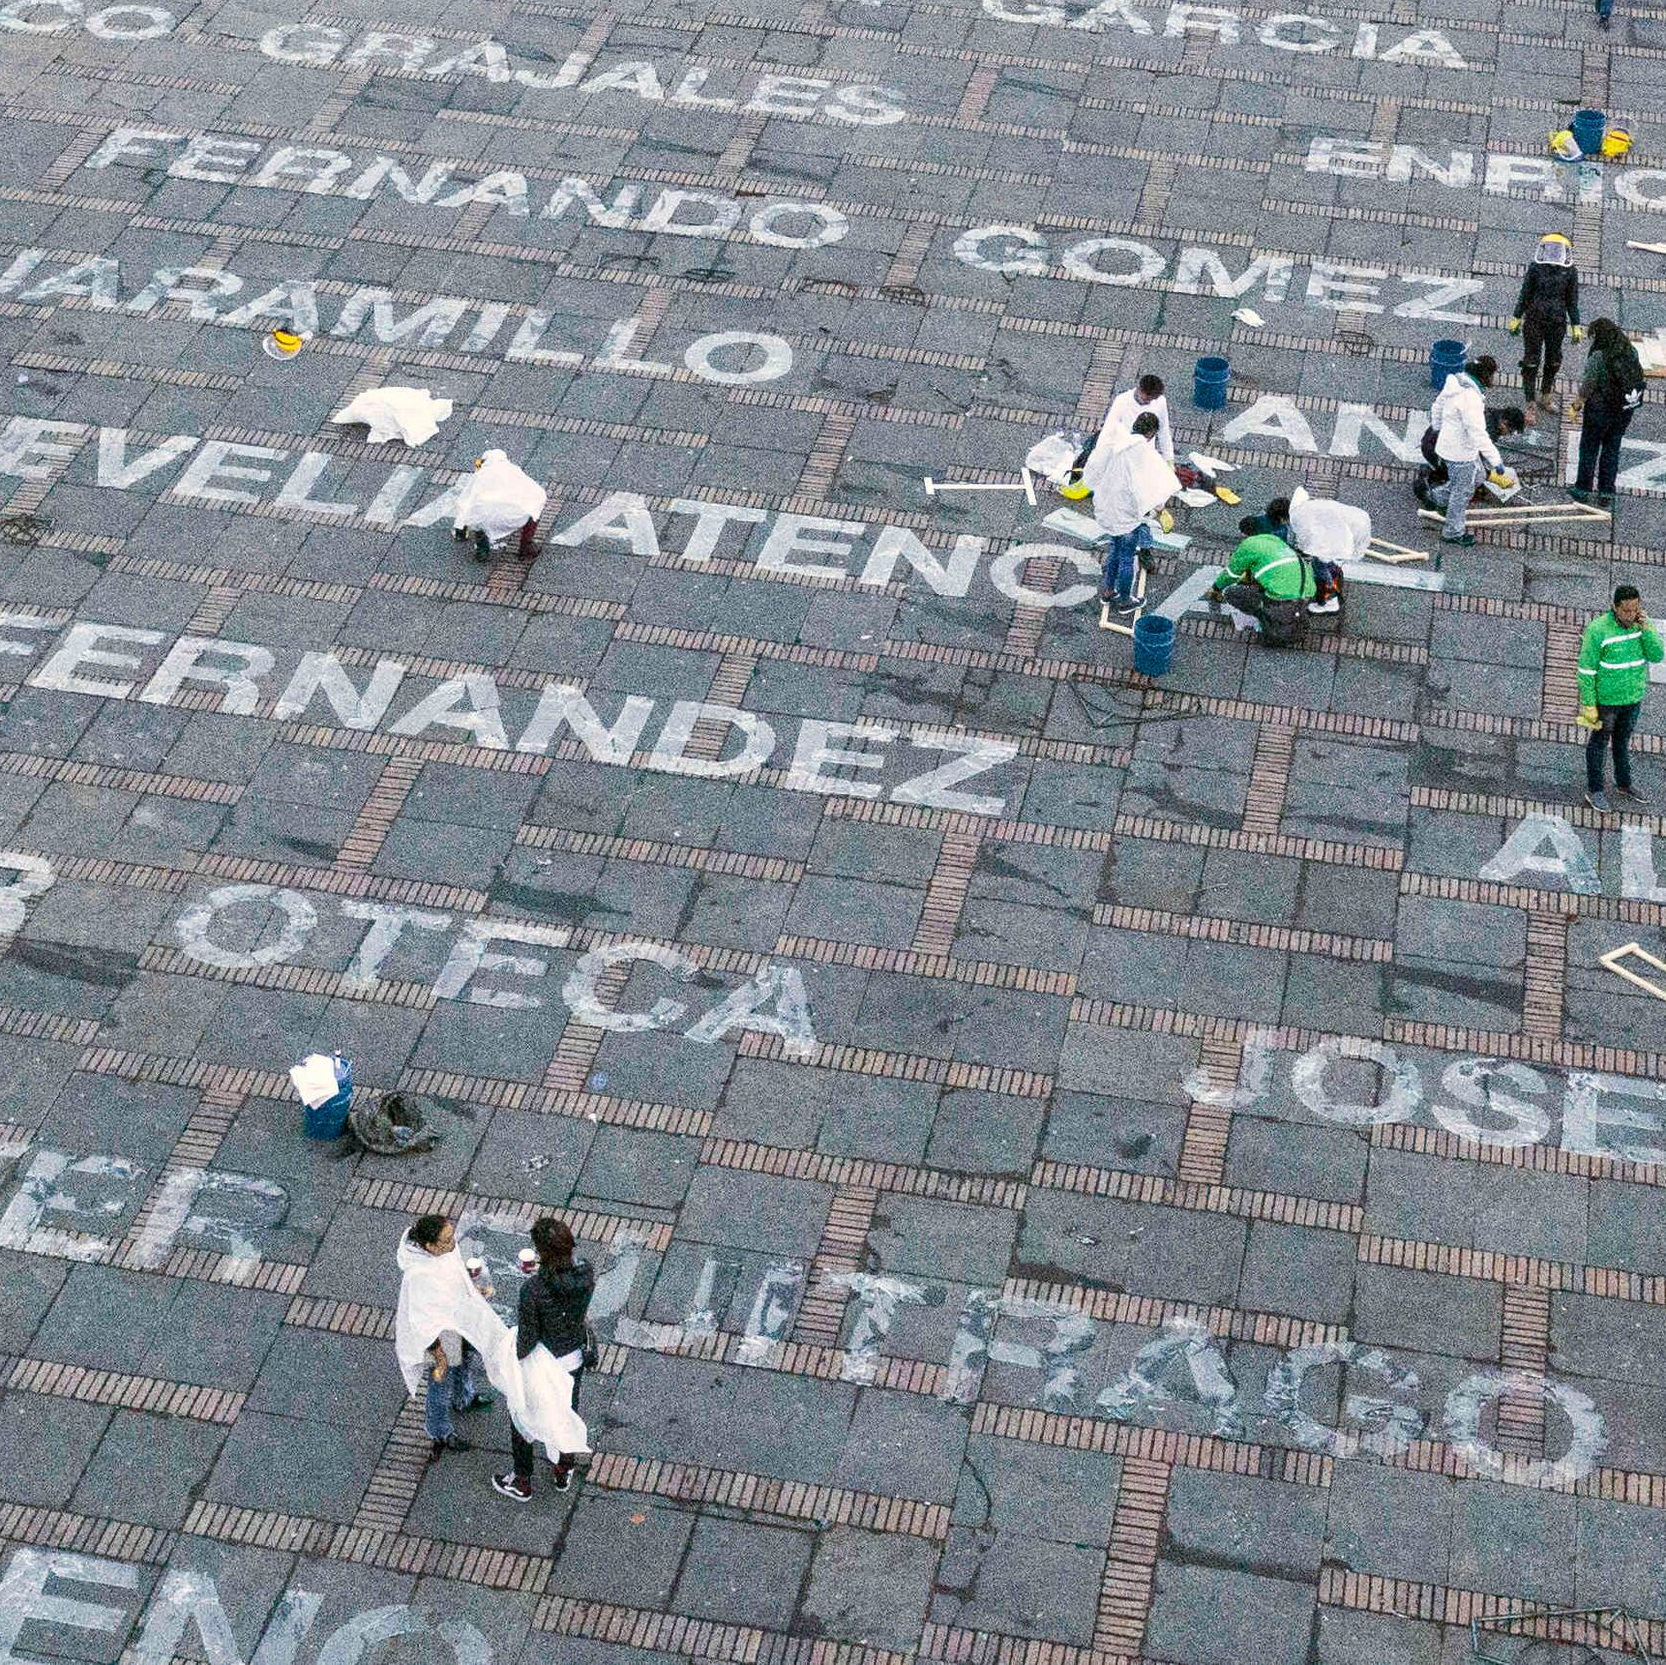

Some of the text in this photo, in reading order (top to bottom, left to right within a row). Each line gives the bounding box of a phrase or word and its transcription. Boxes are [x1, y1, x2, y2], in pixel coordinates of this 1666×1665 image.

[258, 21, 908, 128] GRAJALES
[85, 126, 852, 251] FERNANDO
[951, 224, 1488, 327] GOMEZ
[172, 880, 821, 1059] OTECA
